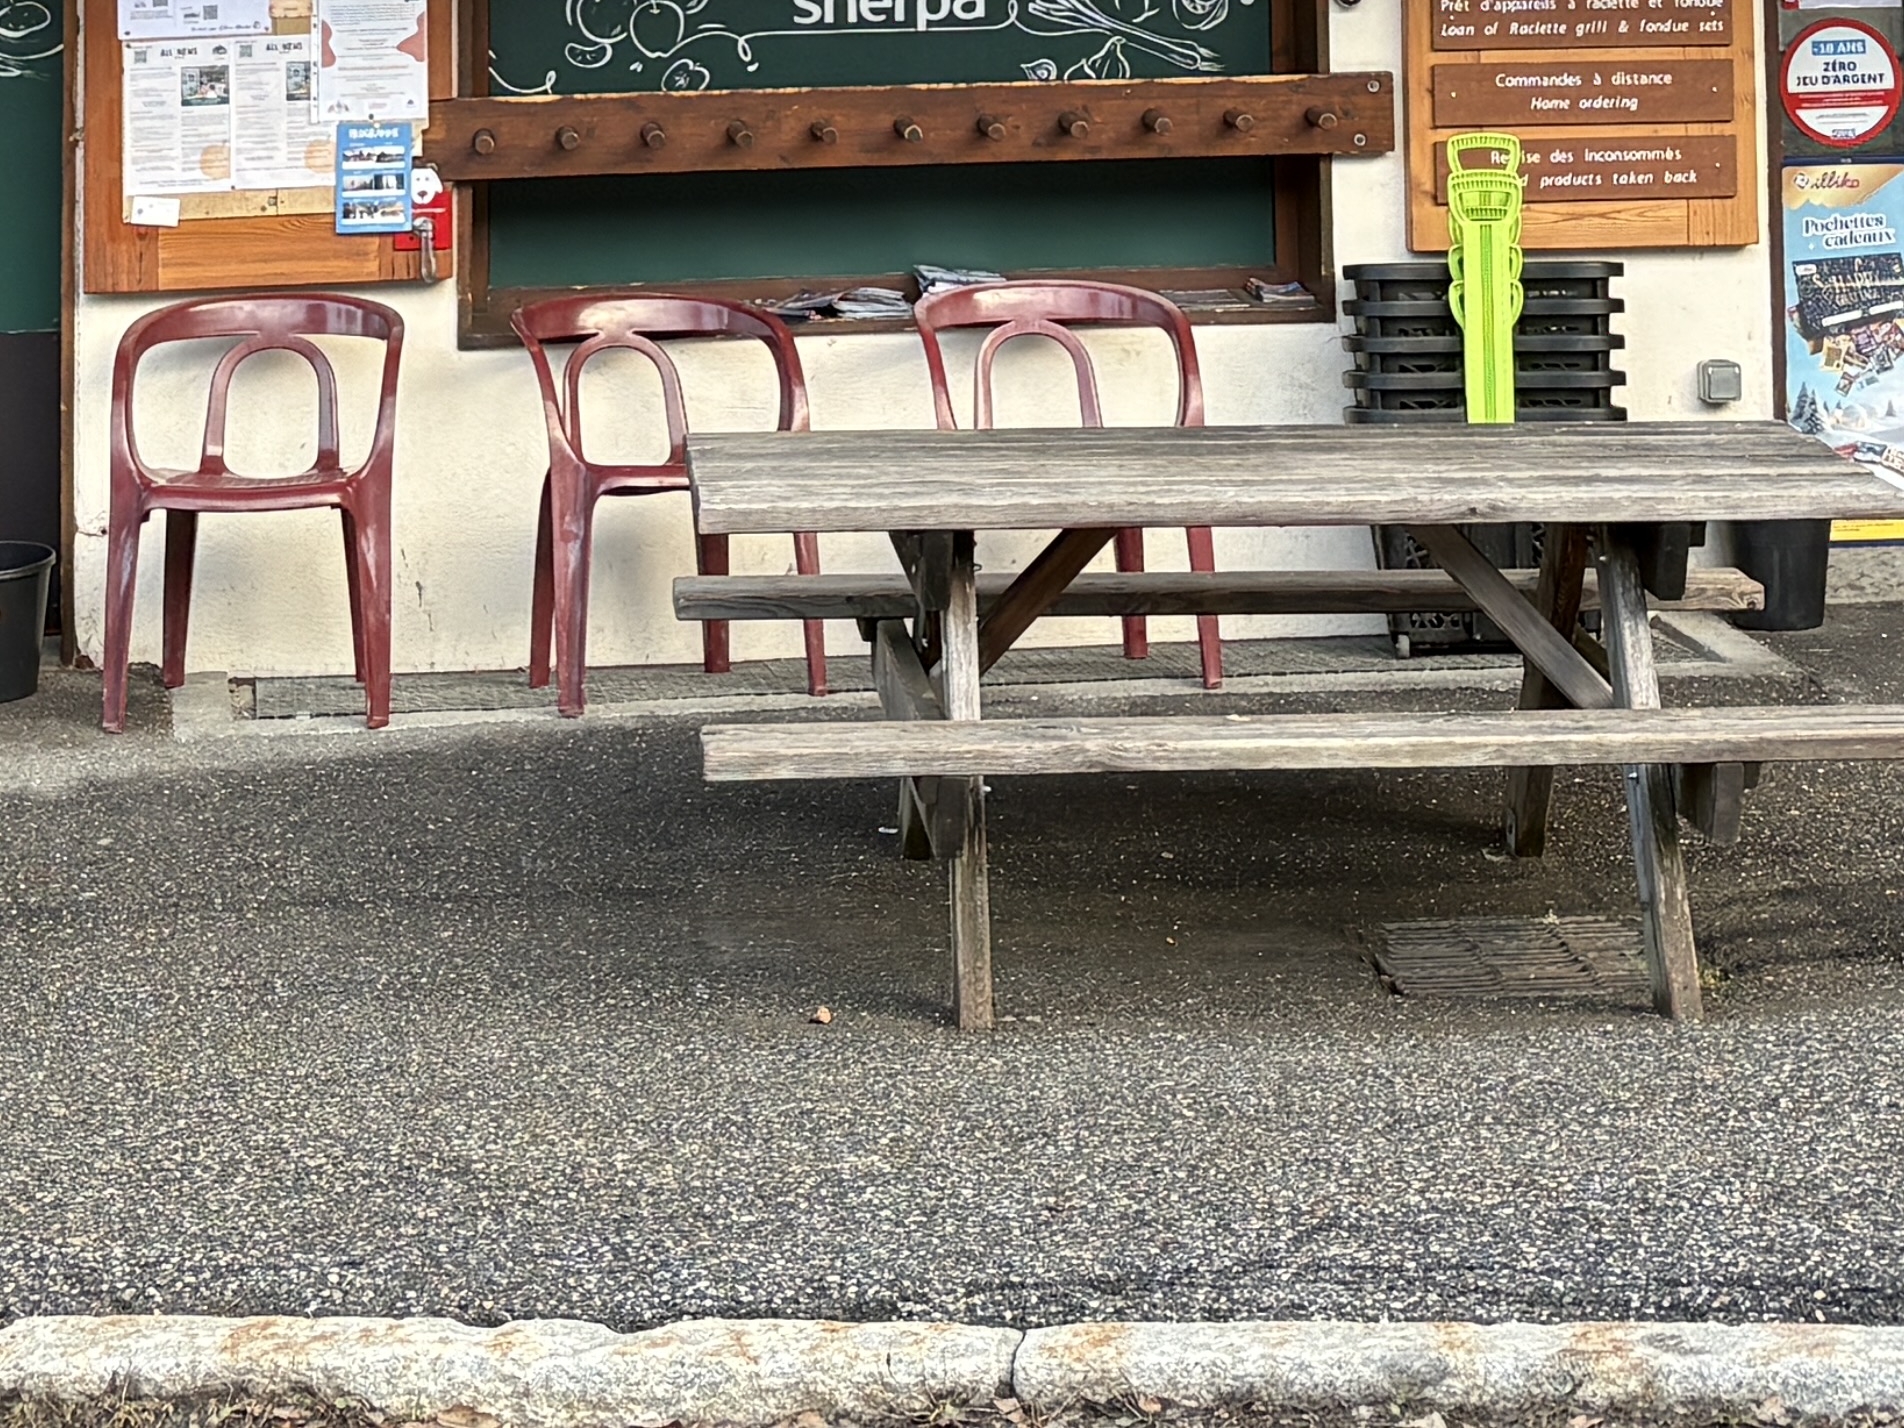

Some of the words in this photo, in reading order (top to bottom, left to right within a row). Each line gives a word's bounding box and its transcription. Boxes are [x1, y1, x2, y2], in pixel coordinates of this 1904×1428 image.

[1440, 22, 1475, 37] Loan
[1484, 21, 1499, 36] of
[1509, 20, 1567, 36] Raclette
[1575, 20, 1608, 38] grill
[1617, 20, 1630, 34] &
[1639, 19, 1690, 33] fondue
[1698, 19, 1724, 33] sets
[1836, 42, 1864, 53] ANS
[1822, 58, 1857, 72] ZÉRO
[1495, 73, 1582, 88] Commandes
[1593, 72, 1602, 86] à
[1611, 71, 1673, 86] distance
[1796, 75, 1818, 87] JEU
[1821, 72, 1885, 86] D'ARGENT
[1530, 97, 1571, 111] Home
[1579, 94, 1639, 112] ordering
[1490, 149, 1541, 164] Reise
[1550, 149, 1574, 163] des
[1539, 171, 1603, 189] products
[1613, 170, 1654, 185] taken
[1664, 169, 1698, 184] back
[1803, 213, 1885, 235] Pochettes
[1824, 228, 1895, 249] cadeaux
